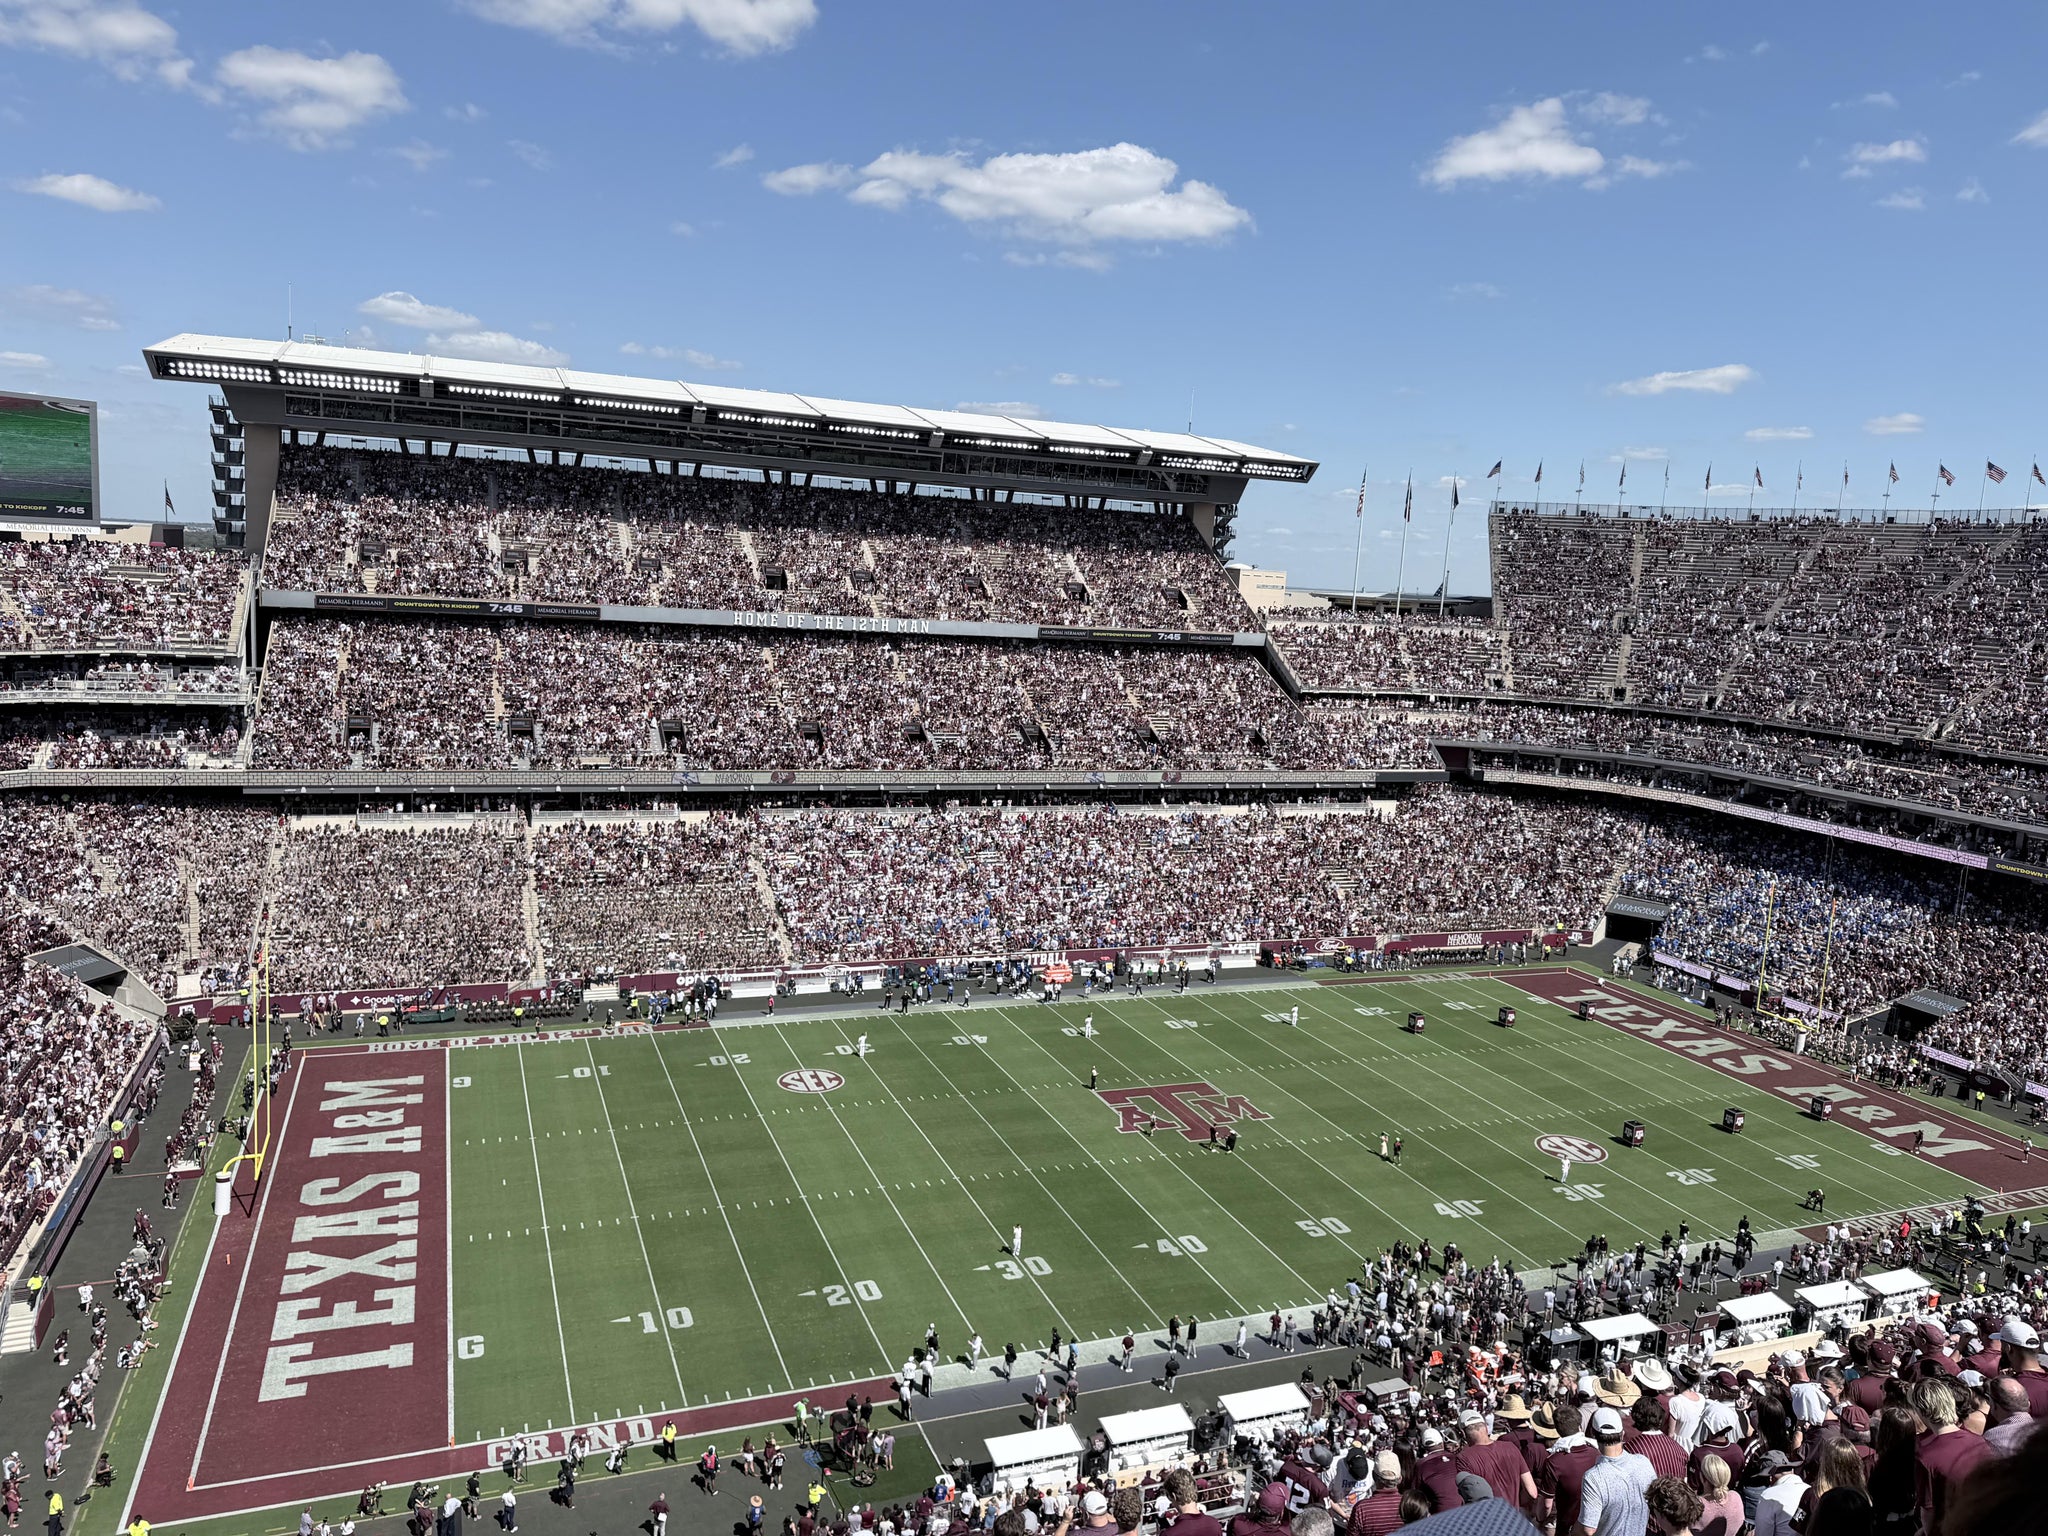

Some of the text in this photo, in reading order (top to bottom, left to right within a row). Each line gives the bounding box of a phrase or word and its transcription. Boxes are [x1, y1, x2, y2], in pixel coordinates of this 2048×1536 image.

[56, 506, 85, 514] 7:45
[6, 523, 92, 533] MEMORIAL HERMANN
[489, 603, 523, 613] 7:45
[734, 612, 930, 633] HOME OF THE 12TH MAN
[1157, 633, 1181, 641] 7:45
[1996, 863, 2042, 878] COUNTDOWN
[362, 996, 395, 1005] Google
[1163, 1019, 1199, 1029] 40
[369, 1040, 440, 1054] HOME
[951, 1035, 988, 1046] 40
[708, 1053, 751, 1067] 20
[573, 1065, 611, 1078] 10
[782, 1069, 840, 1092] SEC
[1554, 988, 1996, 1158] TEXAS A&M
[453, 1076, 472, 1088] G
[1540, 1136, 1602, 1163] SEC
[1774, 1154, 1821, 1170] 10
[1666, 1168, 1717, 1186] 20
[1552, 1183, 1605, 1201] 30
[1433, 1200, 1484, 1219] 40
[1295, 1217, 1351, 1238] 50
[258, 1075, 424, 1403] TEXAS A&M
[1156, 1234, 1209, 1258] 40
[994, 1256, 1053, 1281] 30
[821, 1279, 883, 1307] 20
[638, 1306, 694, 1333] 10
[458, 1335, 485, 1360] G
